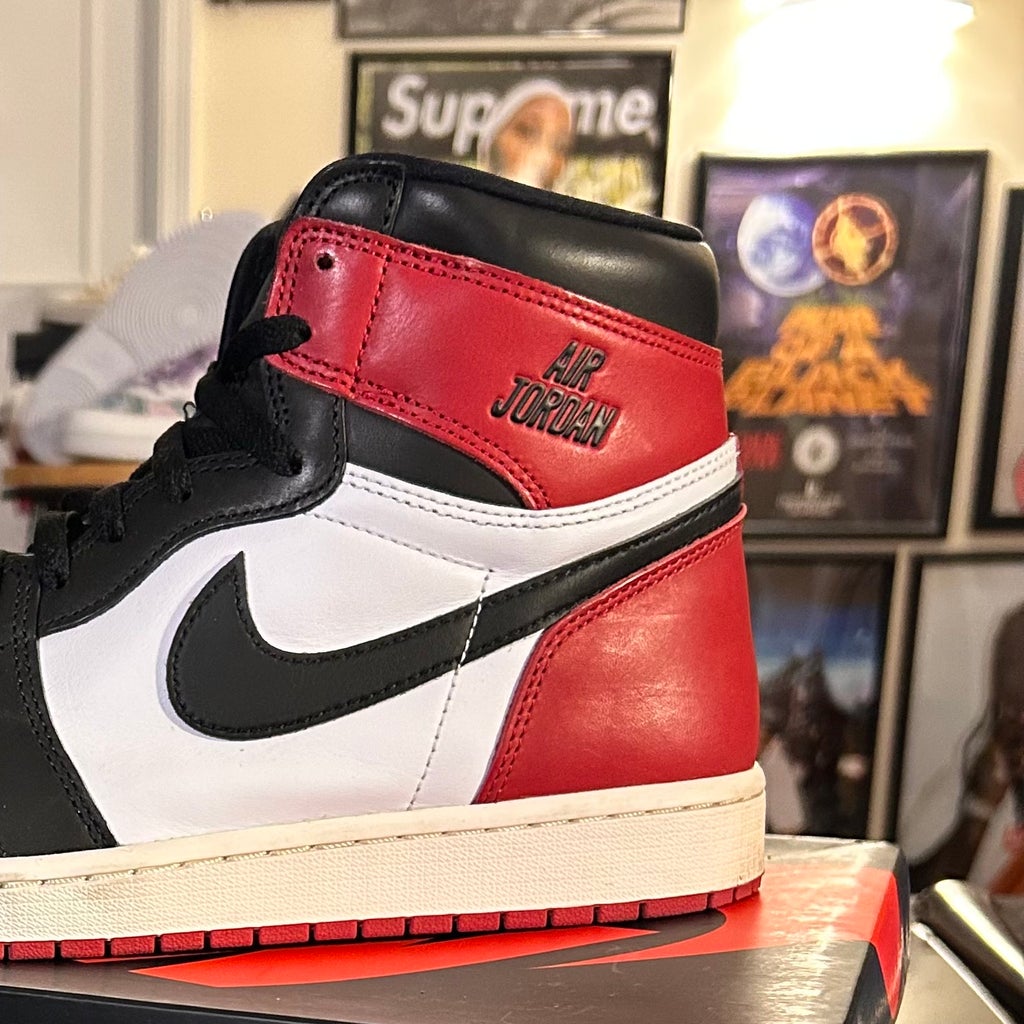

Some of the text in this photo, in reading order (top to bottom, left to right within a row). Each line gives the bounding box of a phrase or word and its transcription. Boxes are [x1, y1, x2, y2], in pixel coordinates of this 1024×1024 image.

[381, 73, 658, 156] Supme
[542, 340, 607, 392] AIR
[490, 376, 619, 447] JORDAN
